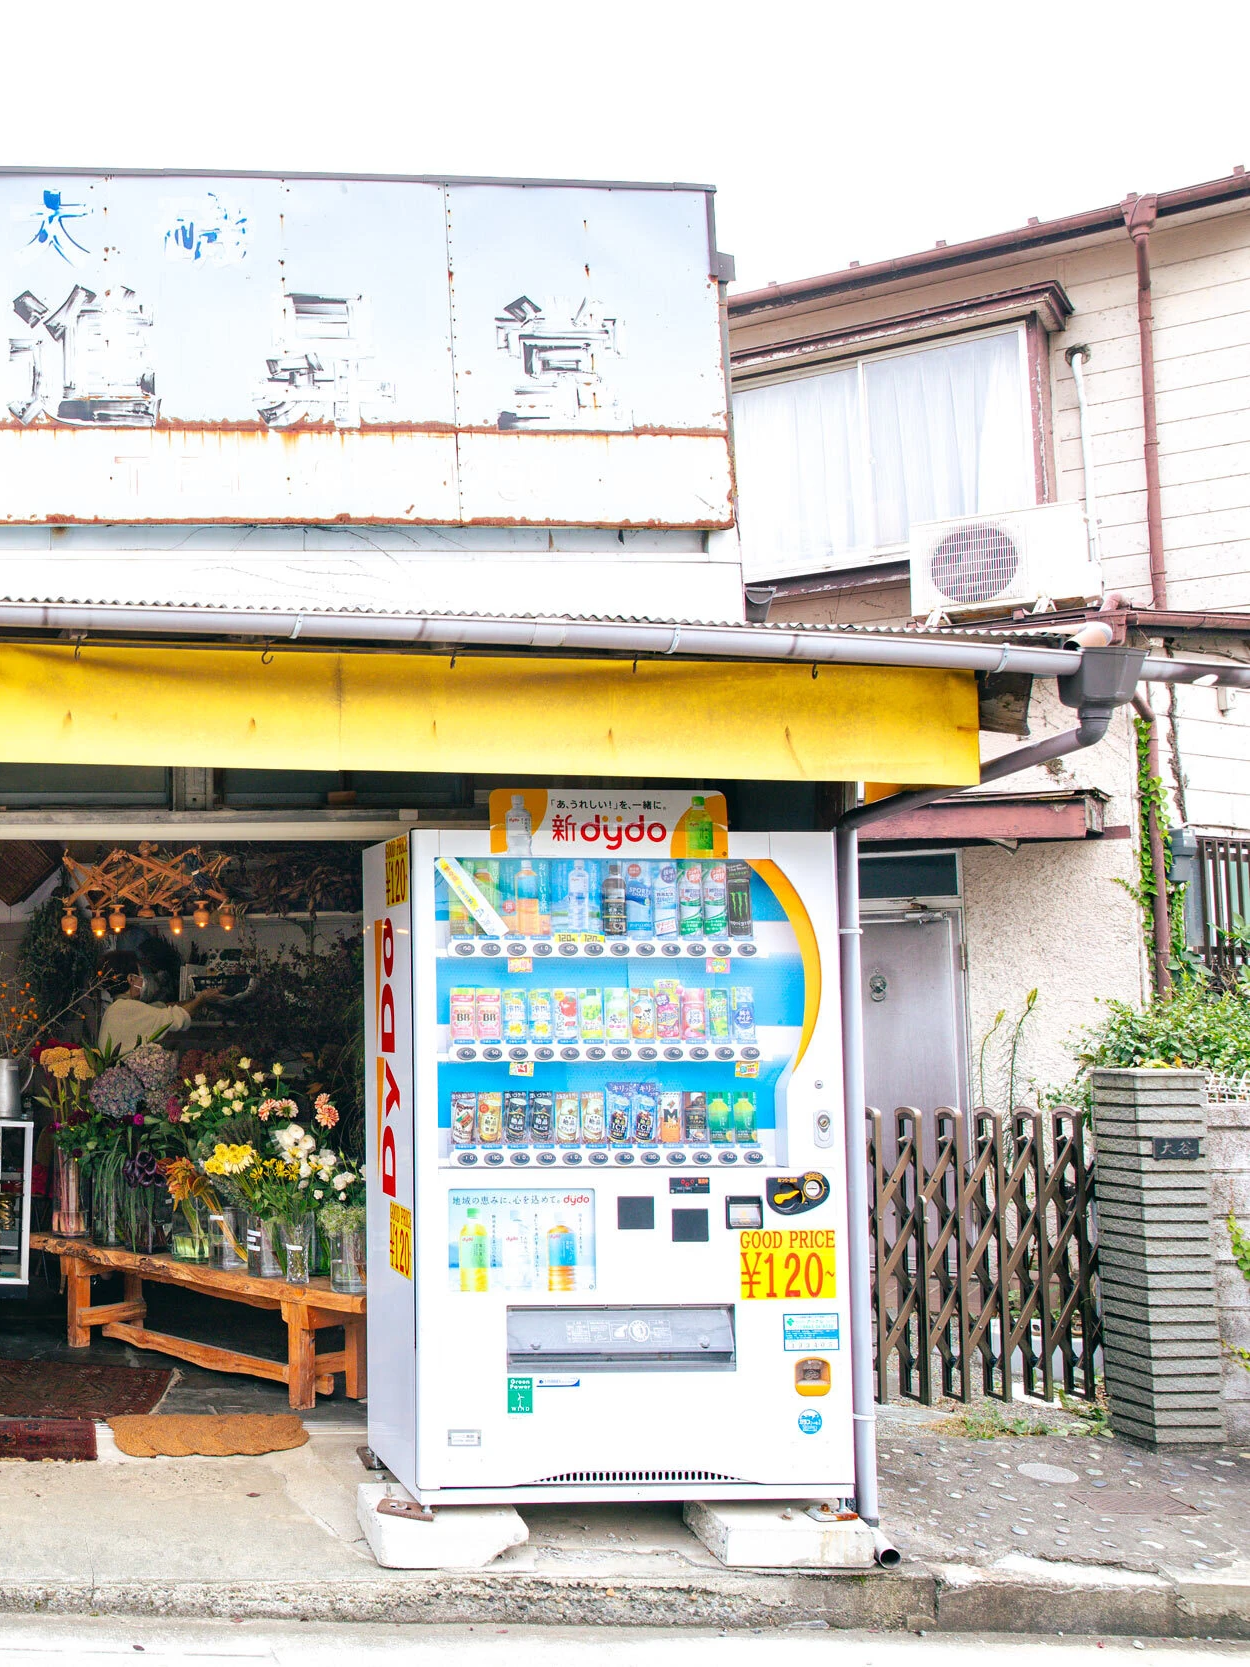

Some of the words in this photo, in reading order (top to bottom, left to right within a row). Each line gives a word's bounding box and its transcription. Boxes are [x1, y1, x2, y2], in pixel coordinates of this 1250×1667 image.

[1160, 1141, 1197, 1155] 大谷
[740, 1231, 783, 1249] GOOD
[789, 1230, 836, 1249] PRICE
